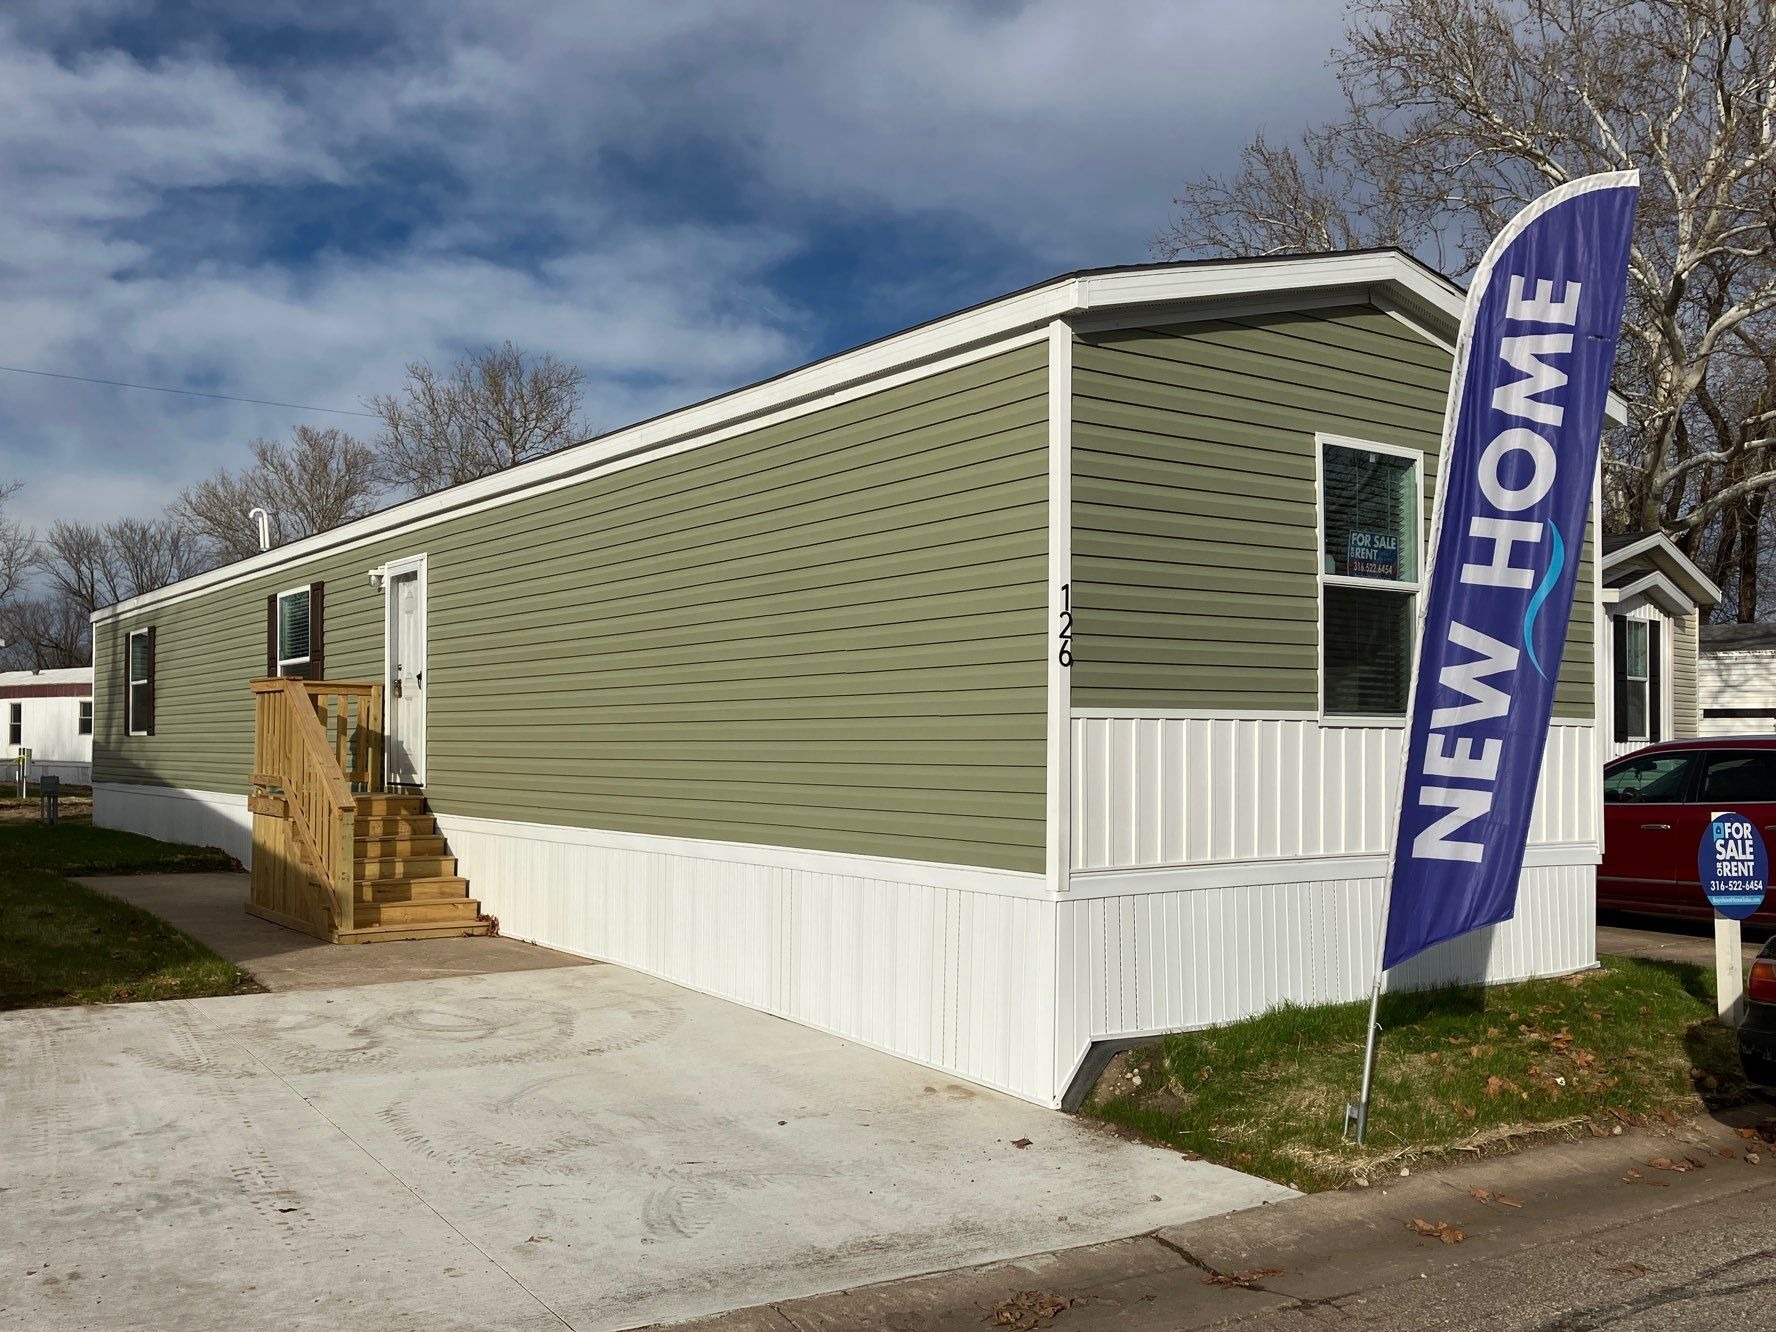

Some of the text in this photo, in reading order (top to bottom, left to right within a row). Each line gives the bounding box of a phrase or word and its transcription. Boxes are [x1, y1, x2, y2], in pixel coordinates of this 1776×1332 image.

[1351, 532, 1396, 549] FOR SALE
[1355, 548, 1378, 560] RENT
[1412, 275, 1581, 863] NEW HOME
[1059, 584, 1073, 667] 126
[1724, 822, 1752, 839] FOR
[1715, 839, 1754, 860] SALE
[1716, 861, 1755, 876] OR RENT
[1710, 880, 1763, 891] 316-522-6454
